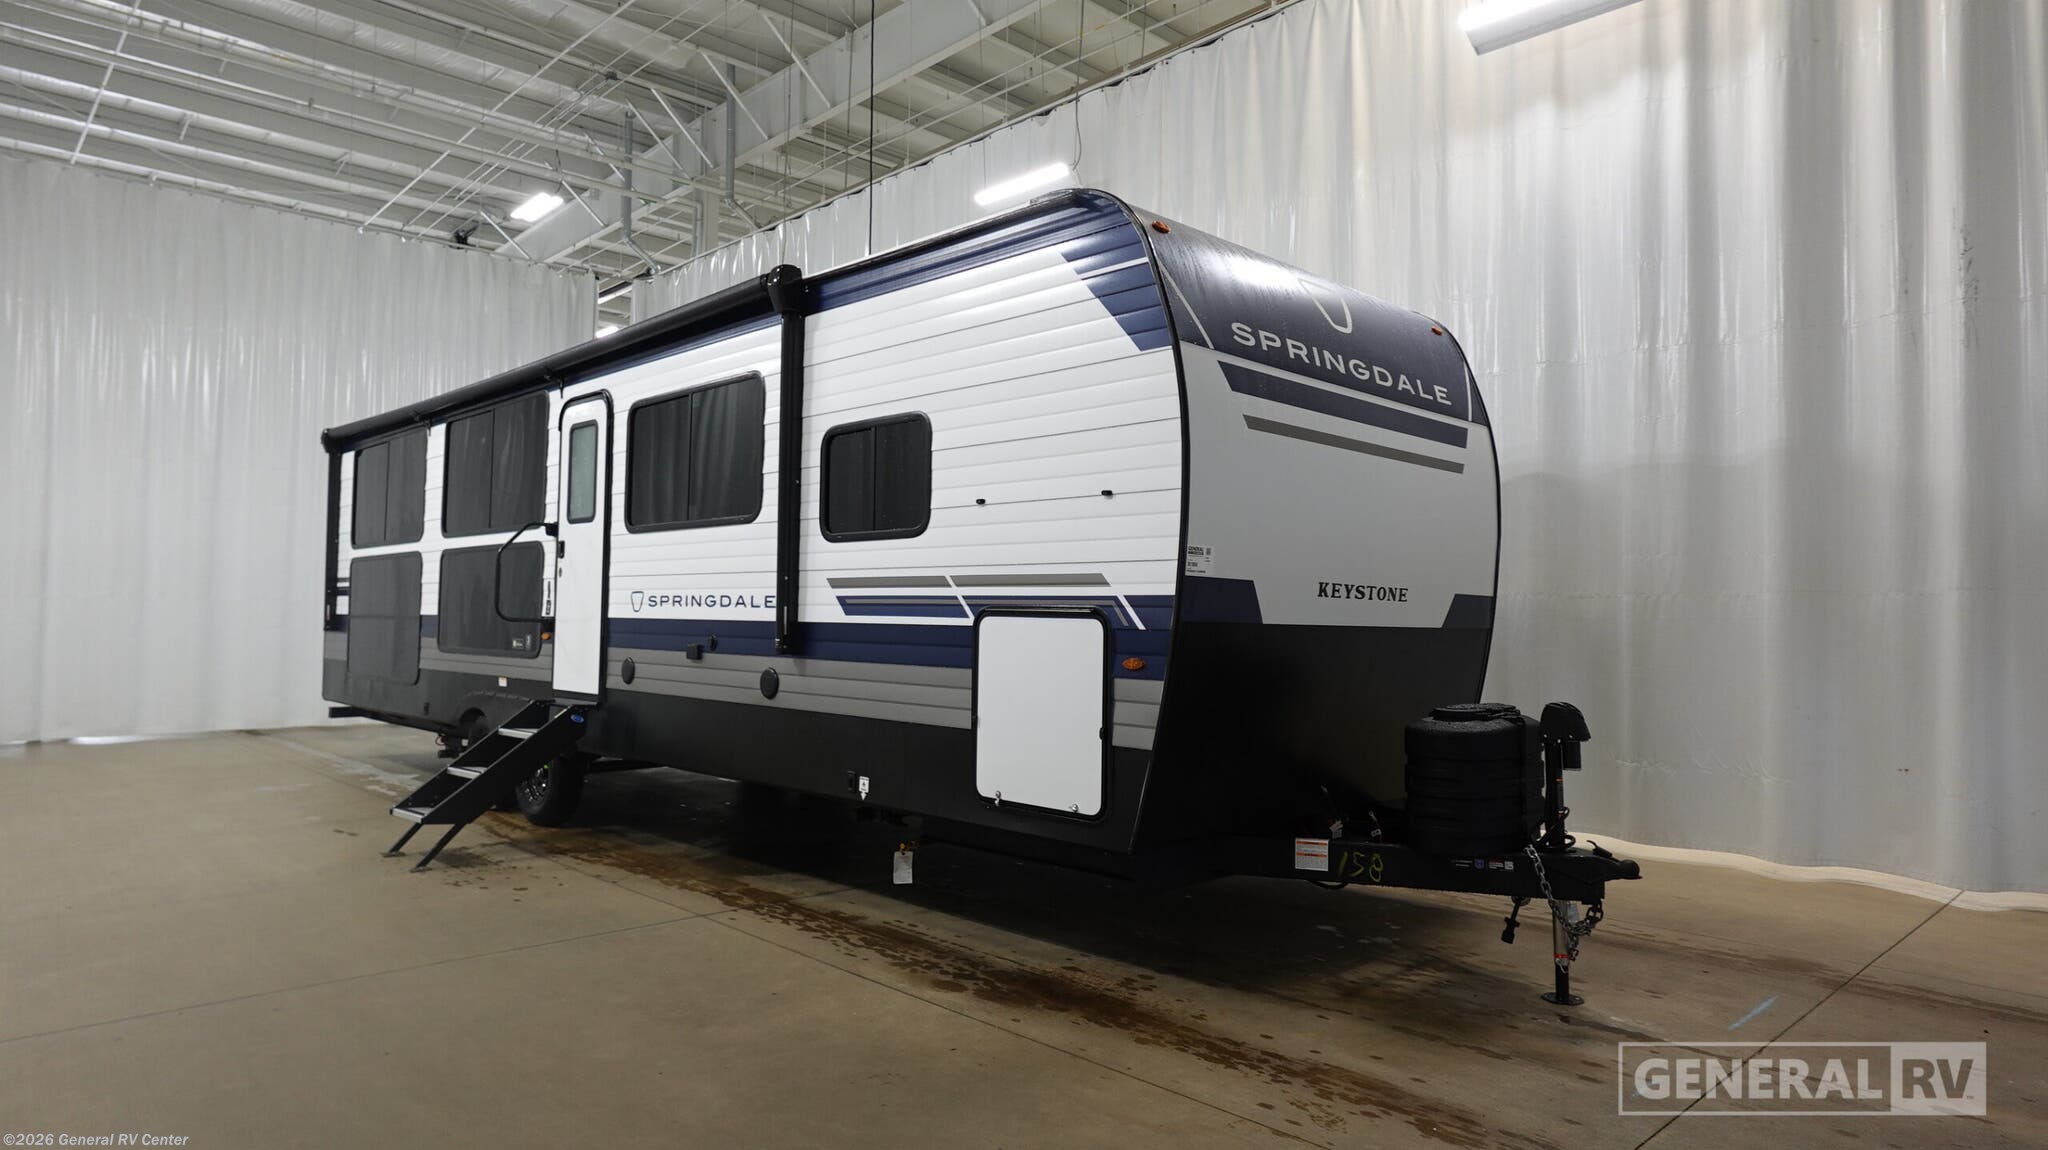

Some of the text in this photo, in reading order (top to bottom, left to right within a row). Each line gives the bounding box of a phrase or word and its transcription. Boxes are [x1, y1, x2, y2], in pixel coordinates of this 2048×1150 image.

[1231, 322, 1453, 406] SPRINGDALE
[648, 595, 776, 608] SPRINGDALE
[1317, 581, 1409, 602] KEYSTONE
